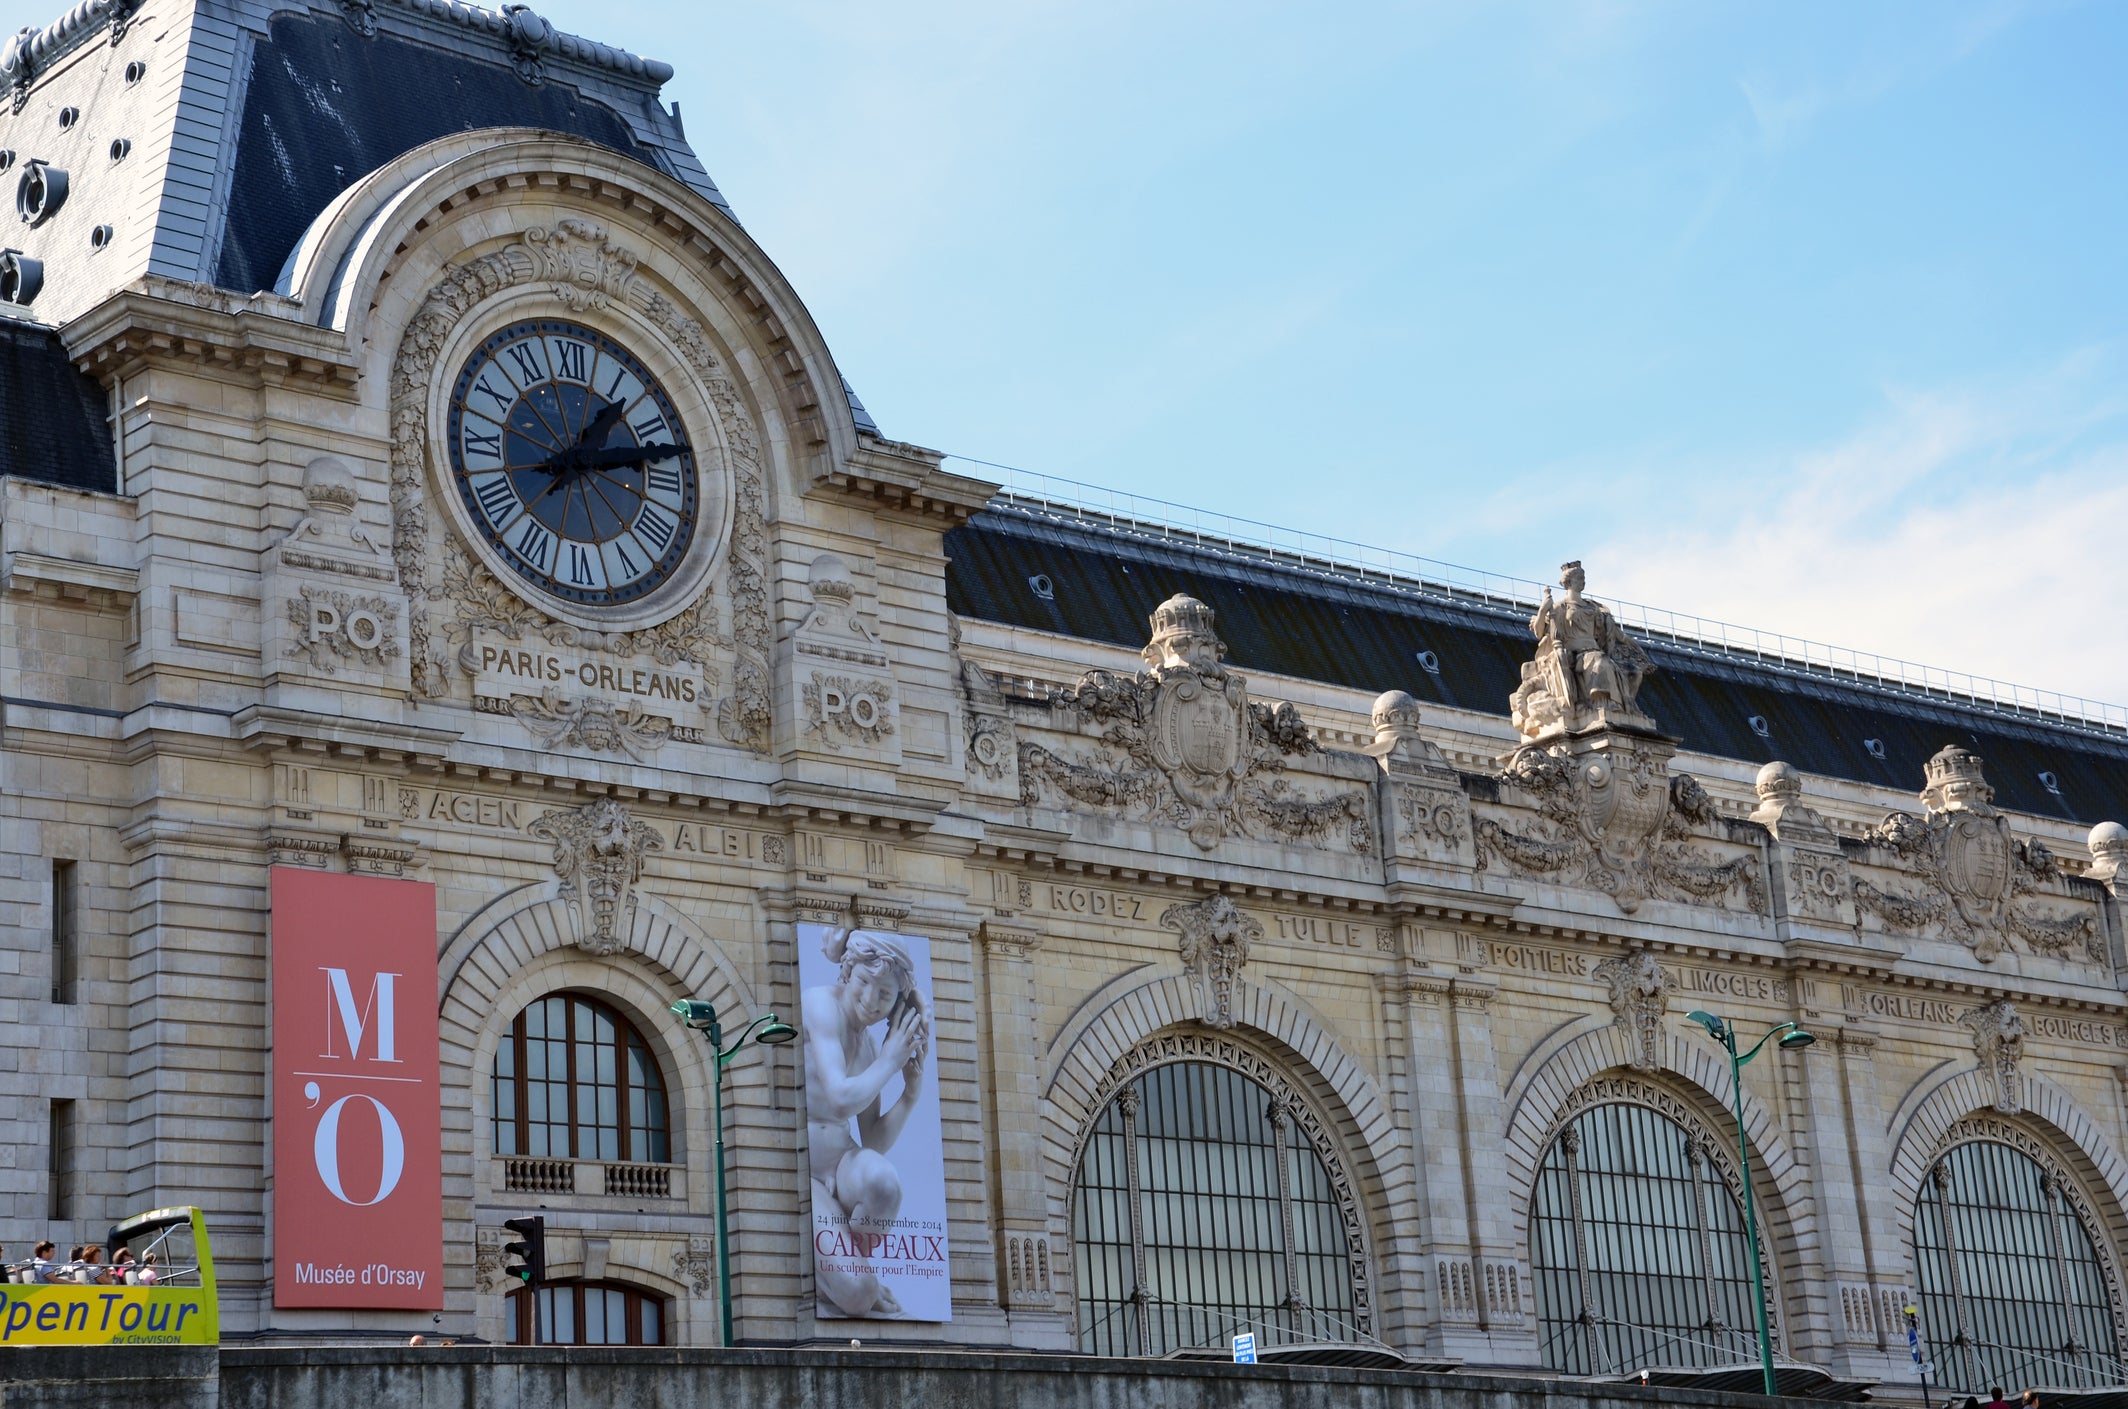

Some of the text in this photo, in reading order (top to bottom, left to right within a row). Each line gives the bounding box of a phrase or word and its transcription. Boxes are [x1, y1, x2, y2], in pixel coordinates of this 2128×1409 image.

[507, 342, 545, 387] XI
[555, 340, 587, 382] XII
[474, 374, 513, 414] X
[606, 367, 627, 400] I
[465, 426, 501, 460] IX
[633, 414, 667, 441] II
[647, 464, 681, 495] III
[475, 475, 519, 528] VIII
[516, 519, 552, 570] VII
[634, 504, 675, 552] IIII
[569, 544, 595, 585] VI
[615, 541, 640, 579] V
[309, 600, 383, 650] PO
[482, 645, 696, 703] PARIS-ORLEANS
[820, 685, 880, 729] PO
[428, 792, 522, 830] AGEN
[674, 824, 754, 859] ALBI
[1051, 885, 1148, 921] RODEZ
[1274, 914, 1363, 948] TULLE
[1489, 943, 1588, 977] POITIERS
[1678, 967, 1769, 1000] LIMOGES
[318, 967, 404, 1063] M
[1871, 993, 1956, 1025] ORLEANS
[2031, 1015, 2113, 1045] BOURGES
[817, 1215, 828, 1226] 24
[831, 1212, 850, 1227] juin
[860, 1216, 870, 1226] 28
[872, 1217, 919, 1230] septembre
[922, 1220, 942, 1232] 2014
[815, 1229, 946, 1261] CARPEAUX
[295, 1262, 426, 1290] Musée d'Orsay
[820, 1260, 944, 1279] Un sculpteur pour l'Empire
